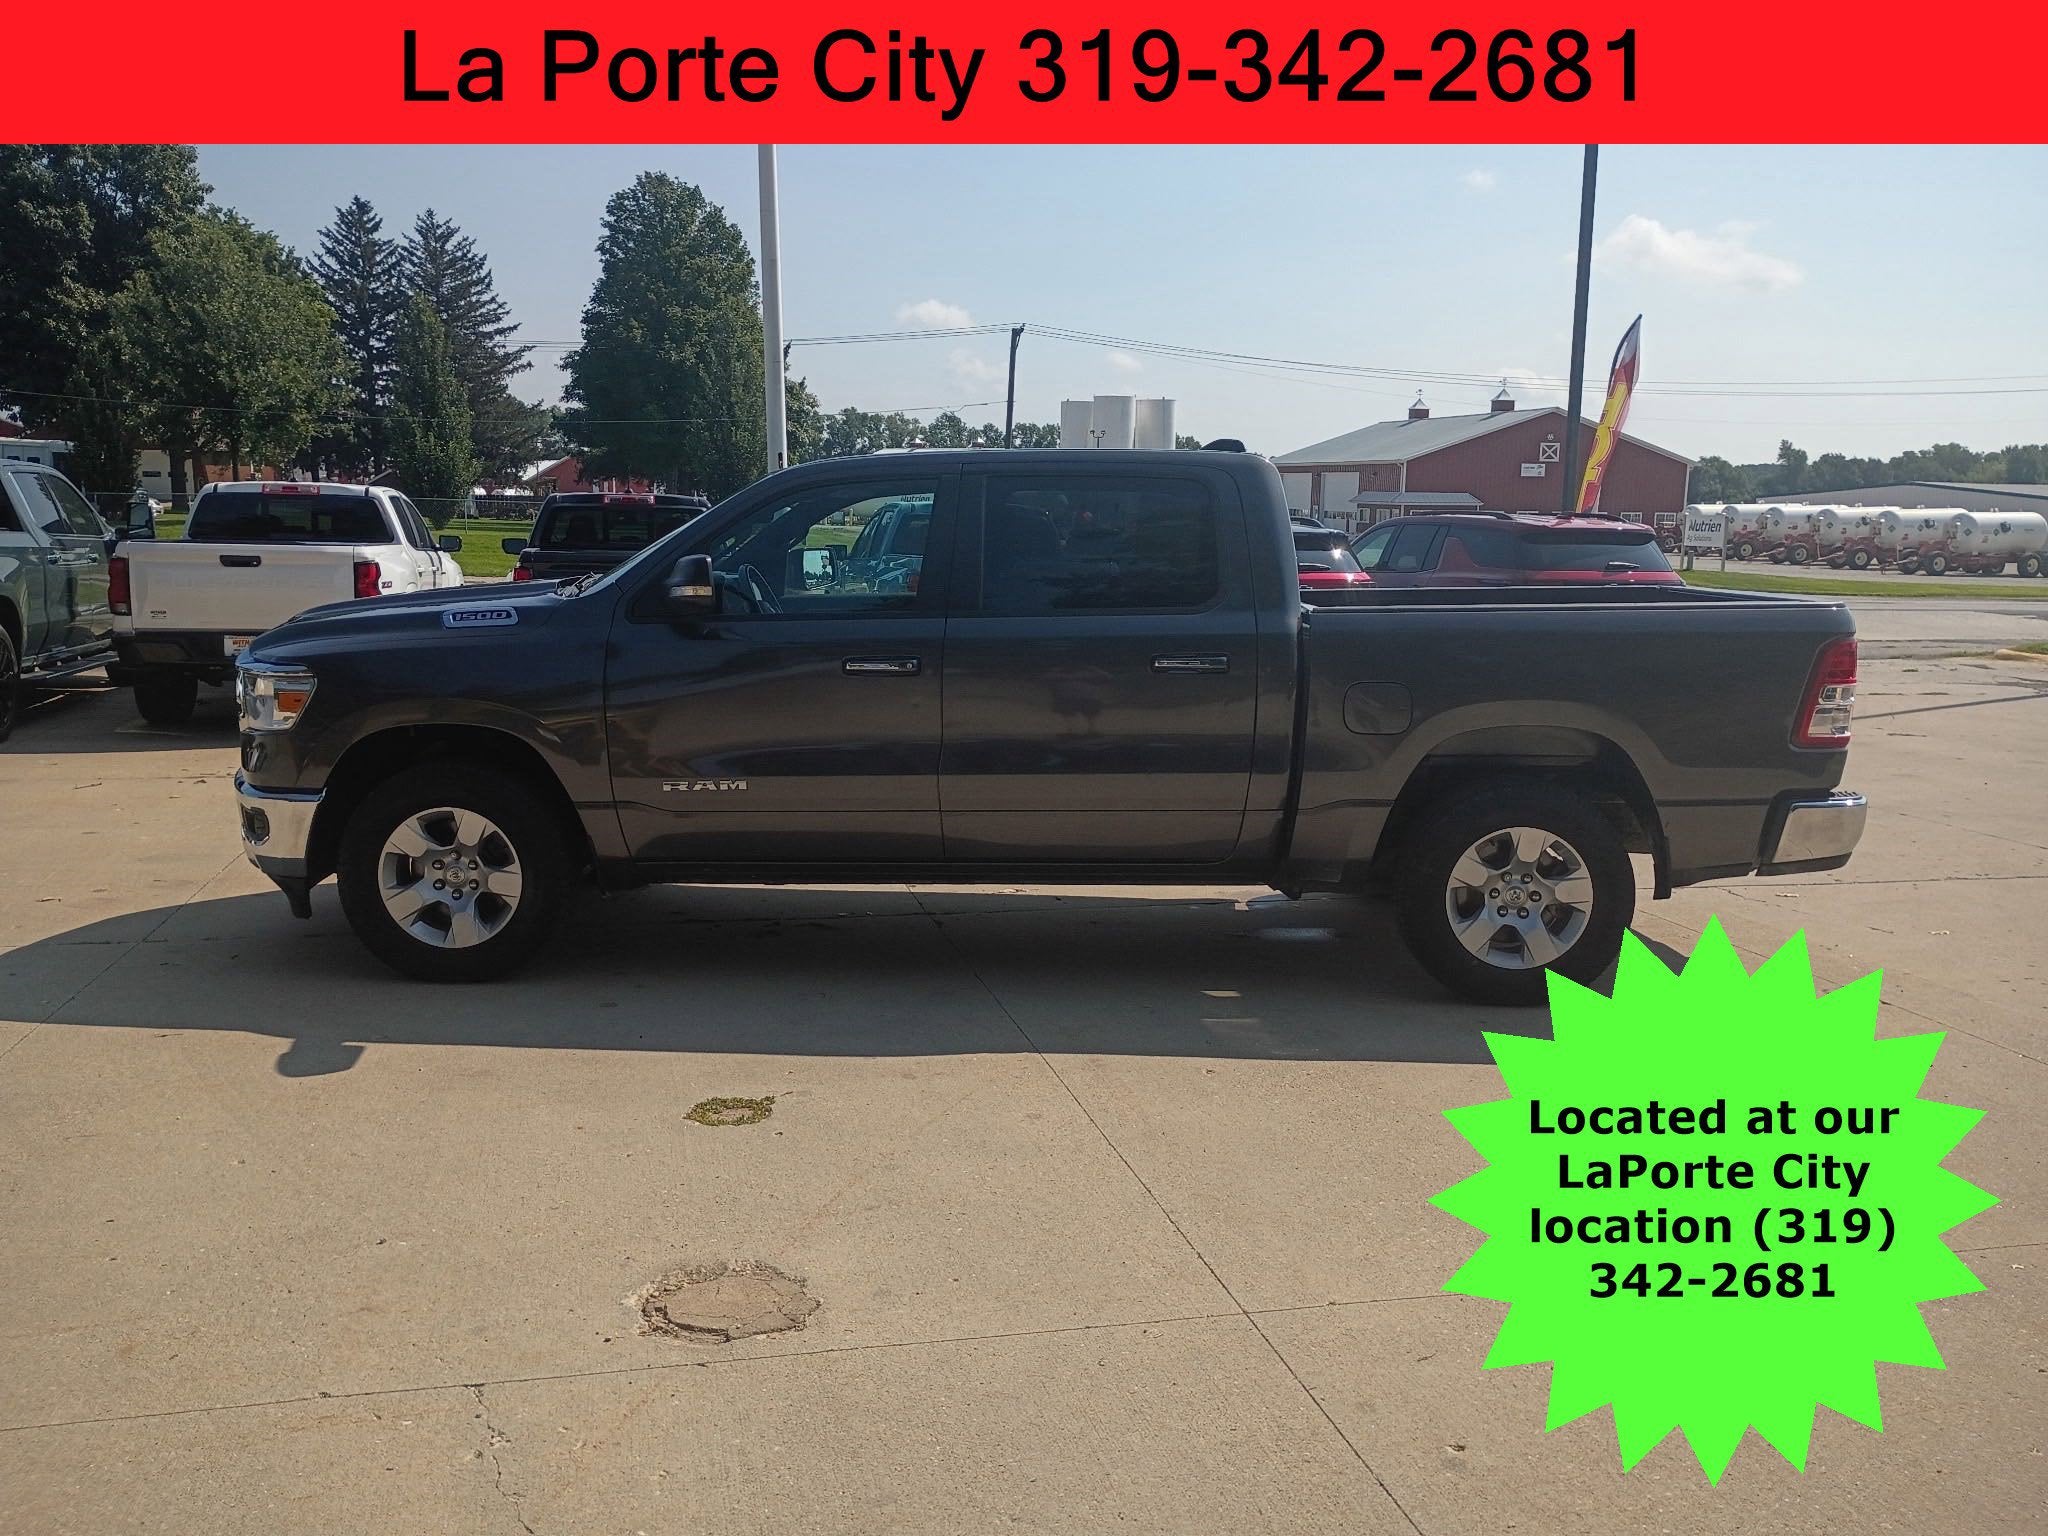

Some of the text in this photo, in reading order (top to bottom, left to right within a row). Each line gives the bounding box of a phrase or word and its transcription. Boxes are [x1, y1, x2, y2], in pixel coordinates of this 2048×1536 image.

[1689, 519, 1722, 532] Nutrien
[455, 611, 507, 621] 1500
[663, 780, 747, 791] RAM
